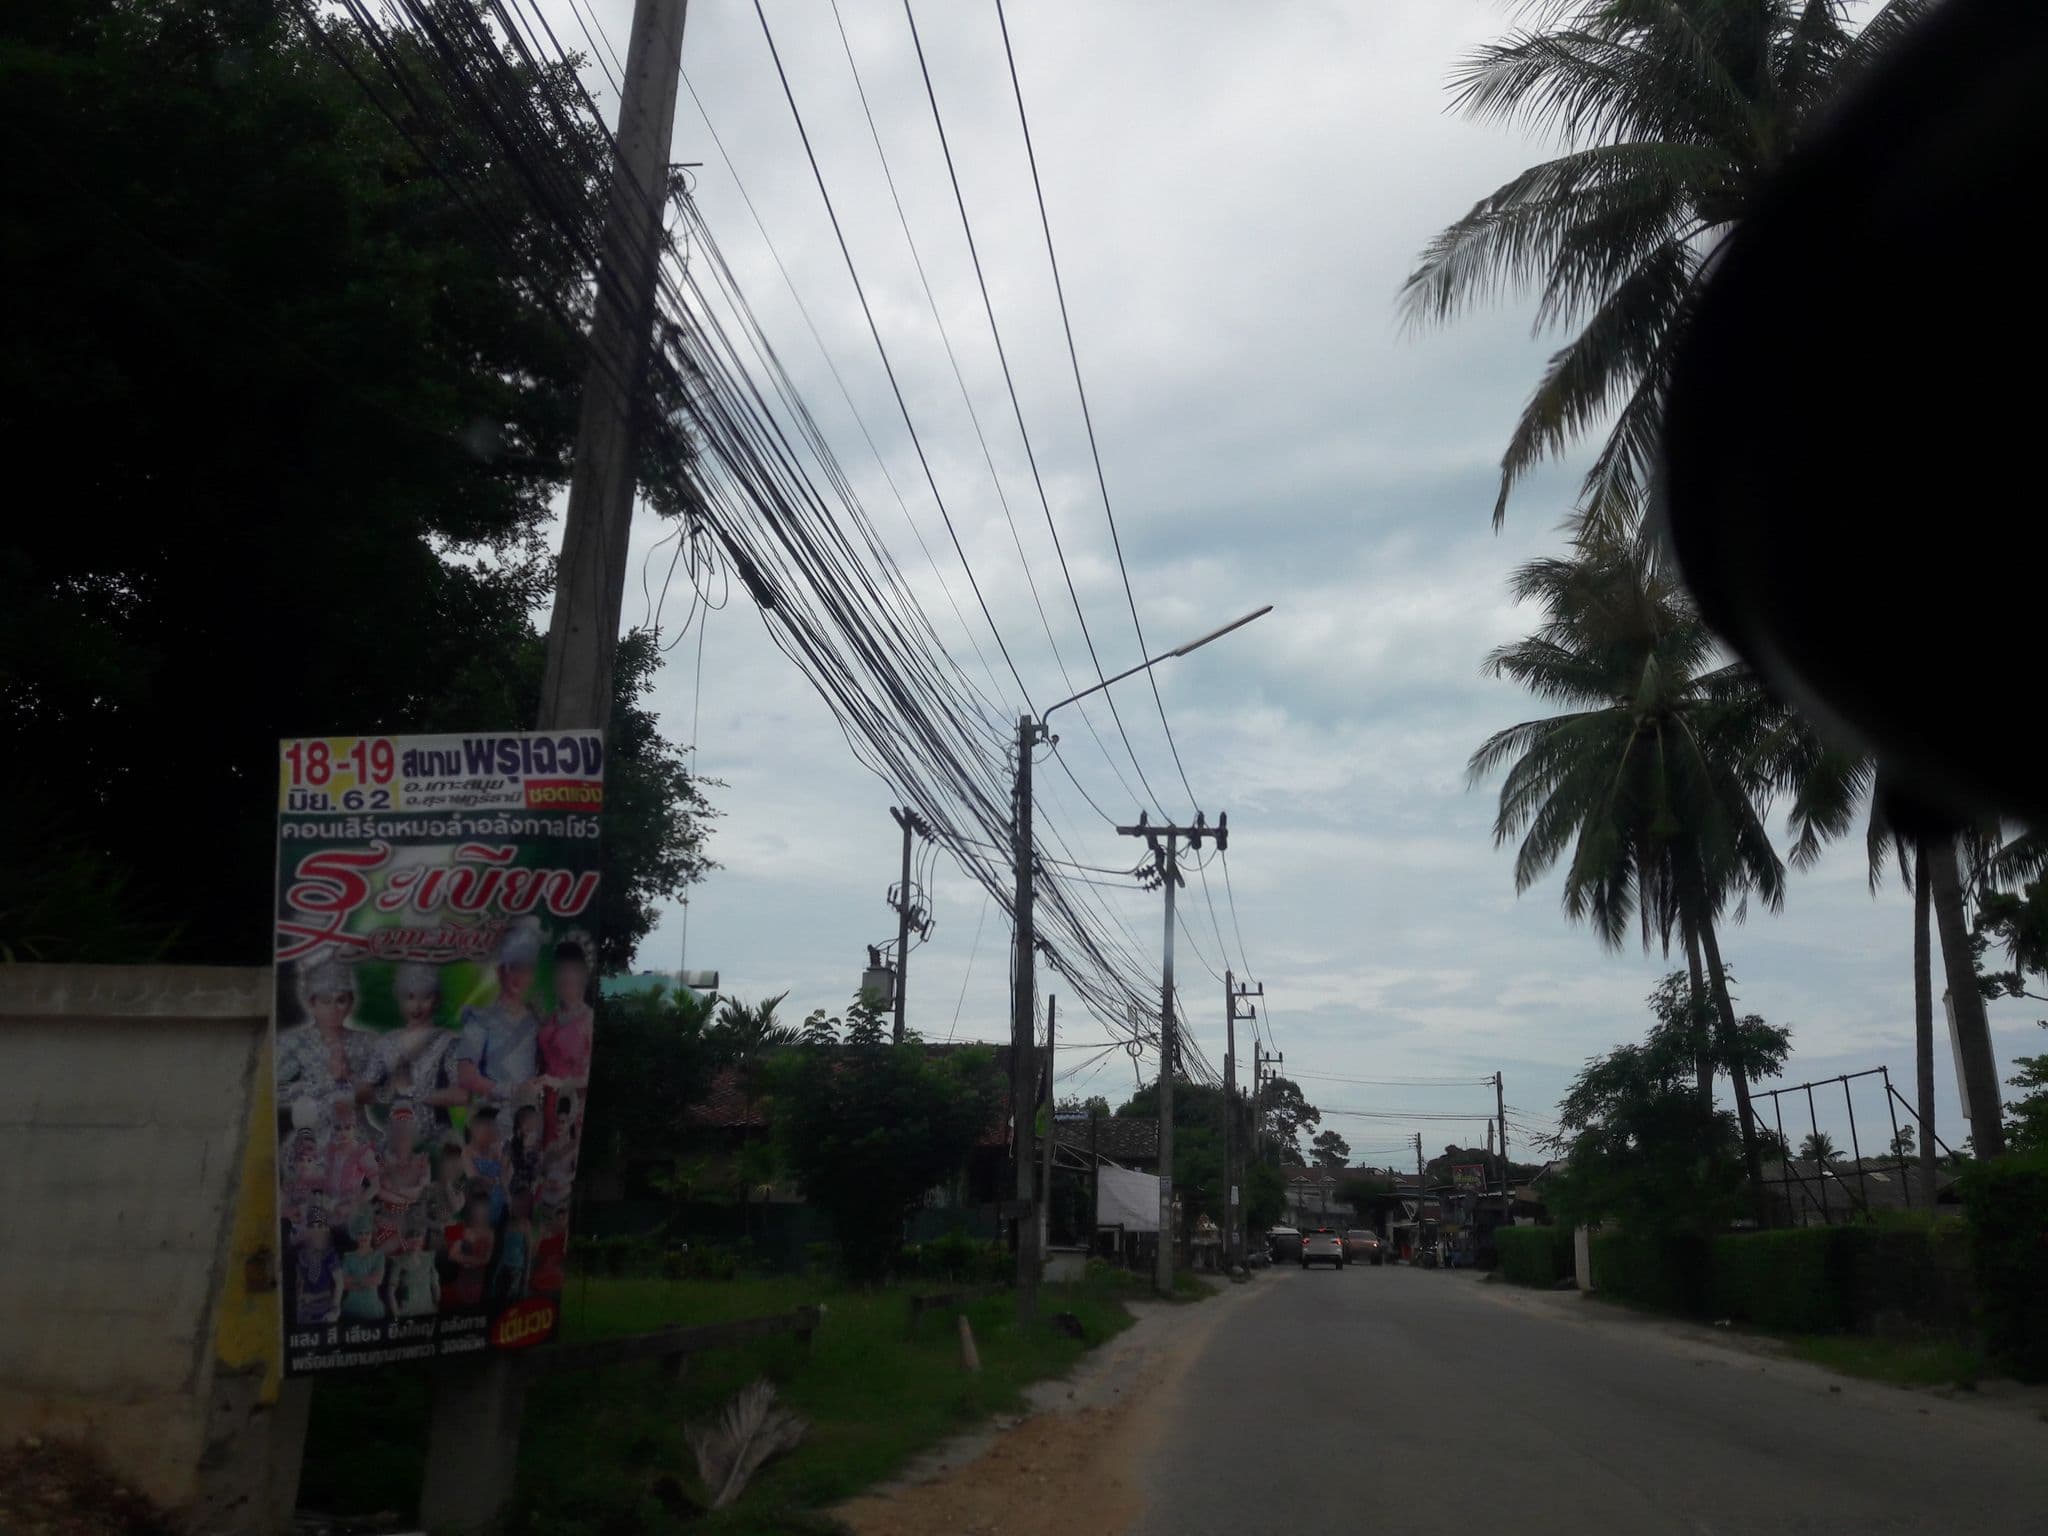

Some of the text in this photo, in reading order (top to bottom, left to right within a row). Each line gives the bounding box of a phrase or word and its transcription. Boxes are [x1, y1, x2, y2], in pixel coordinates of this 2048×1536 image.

[286, 739, 396, 787] 18-19
[401, 749, 461, 779] สนาม
[277, 839, 600, 918] ระเบียบ
